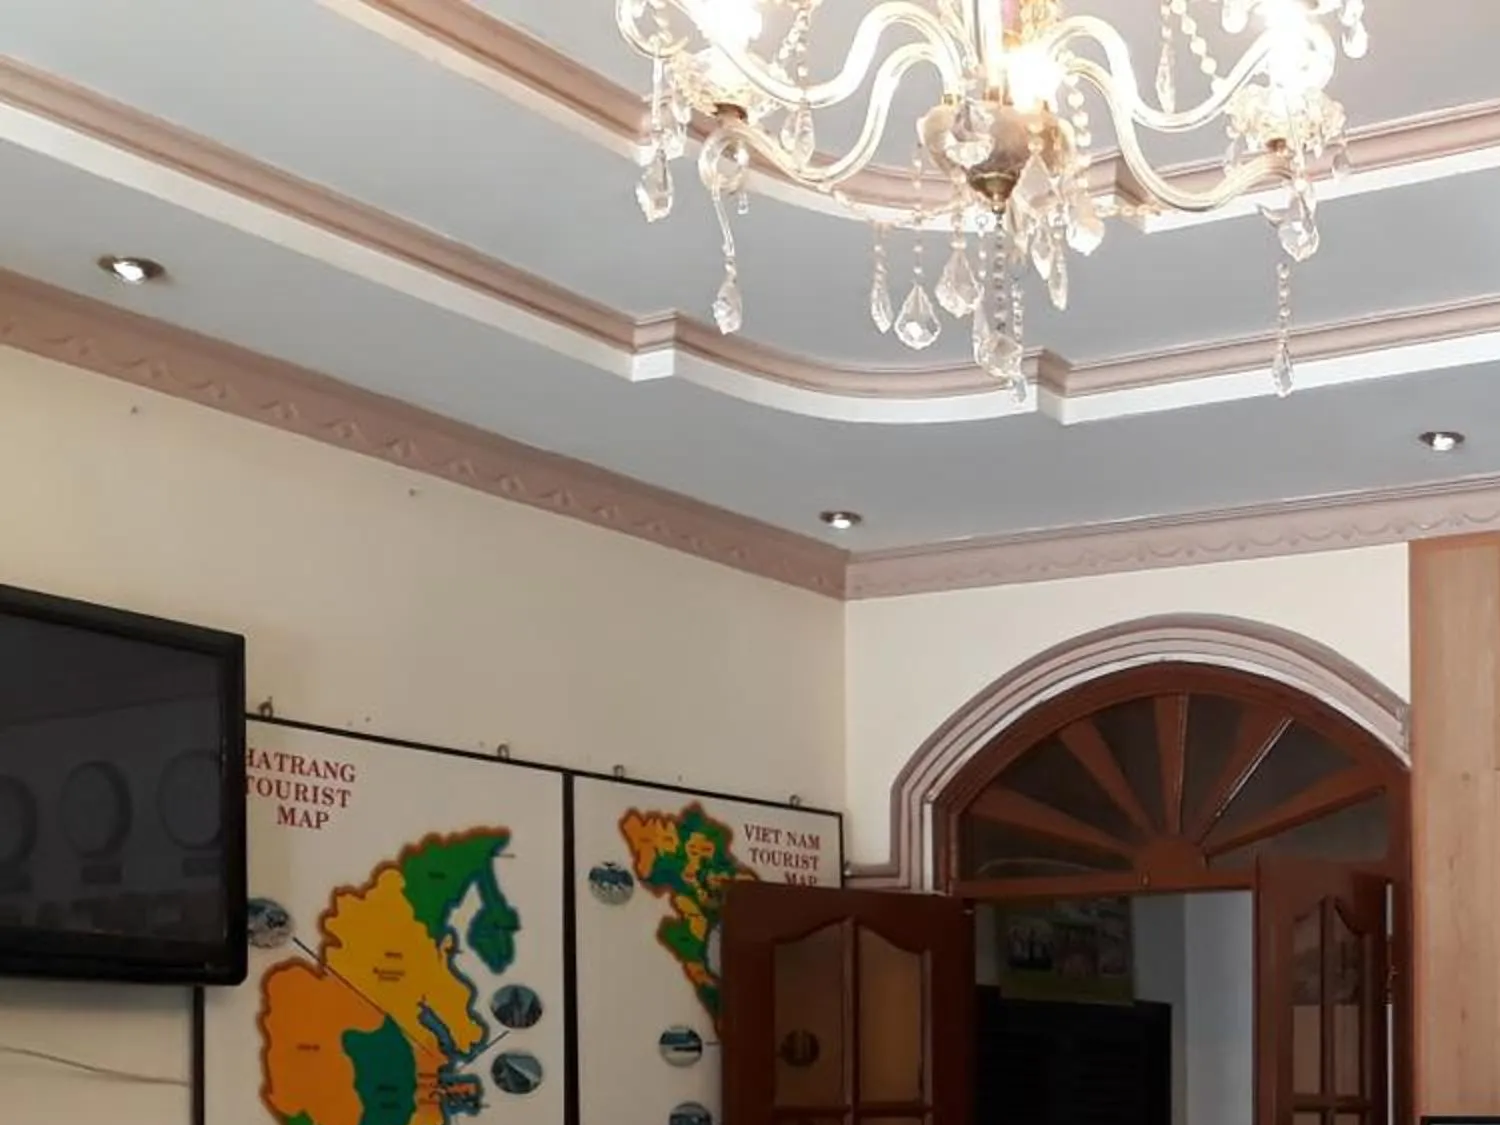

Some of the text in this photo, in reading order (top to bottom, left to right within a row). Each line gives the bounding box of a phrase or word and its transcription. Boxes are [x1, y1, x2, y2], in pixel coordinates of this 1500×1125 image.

[277, 804, 329, 829] MAP
[744, 824, 820, 850] VIET NAM
[748, 847, 818, 871] TOURIST
